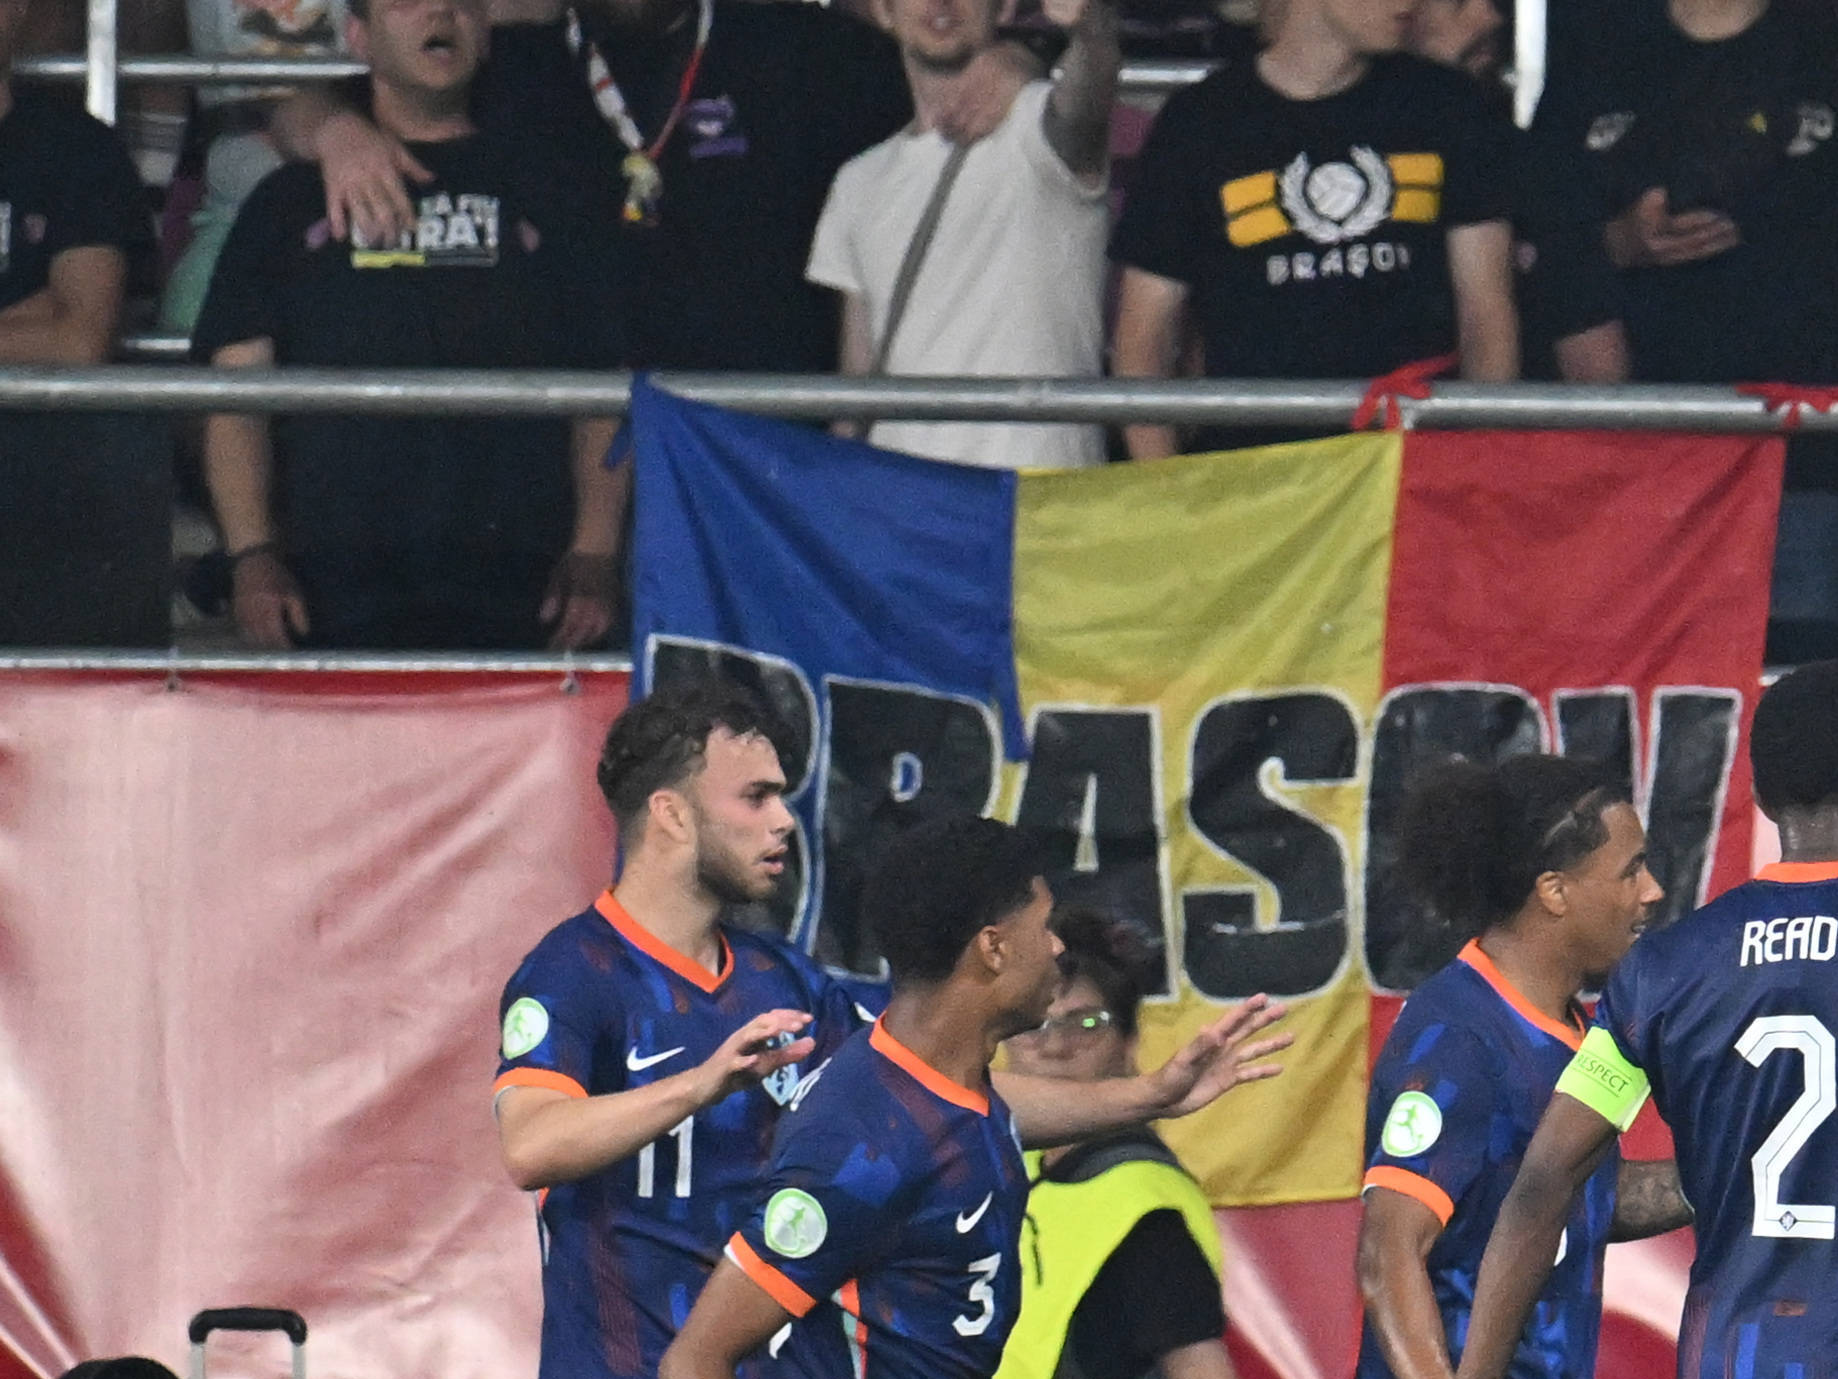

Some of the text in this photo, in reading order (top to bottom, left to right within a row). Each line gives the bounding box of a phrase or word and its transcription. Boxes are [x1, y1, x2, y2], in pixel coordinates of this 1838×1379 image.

[1740, 915, 1838, 967] READ
[1576, 1054, 1629, 1093] RESPECT
[636, 1114, 694, 1198] 11
[1735, 1014, 1838, 1240] 2
[951, 1252, 1001, 1337] 3
